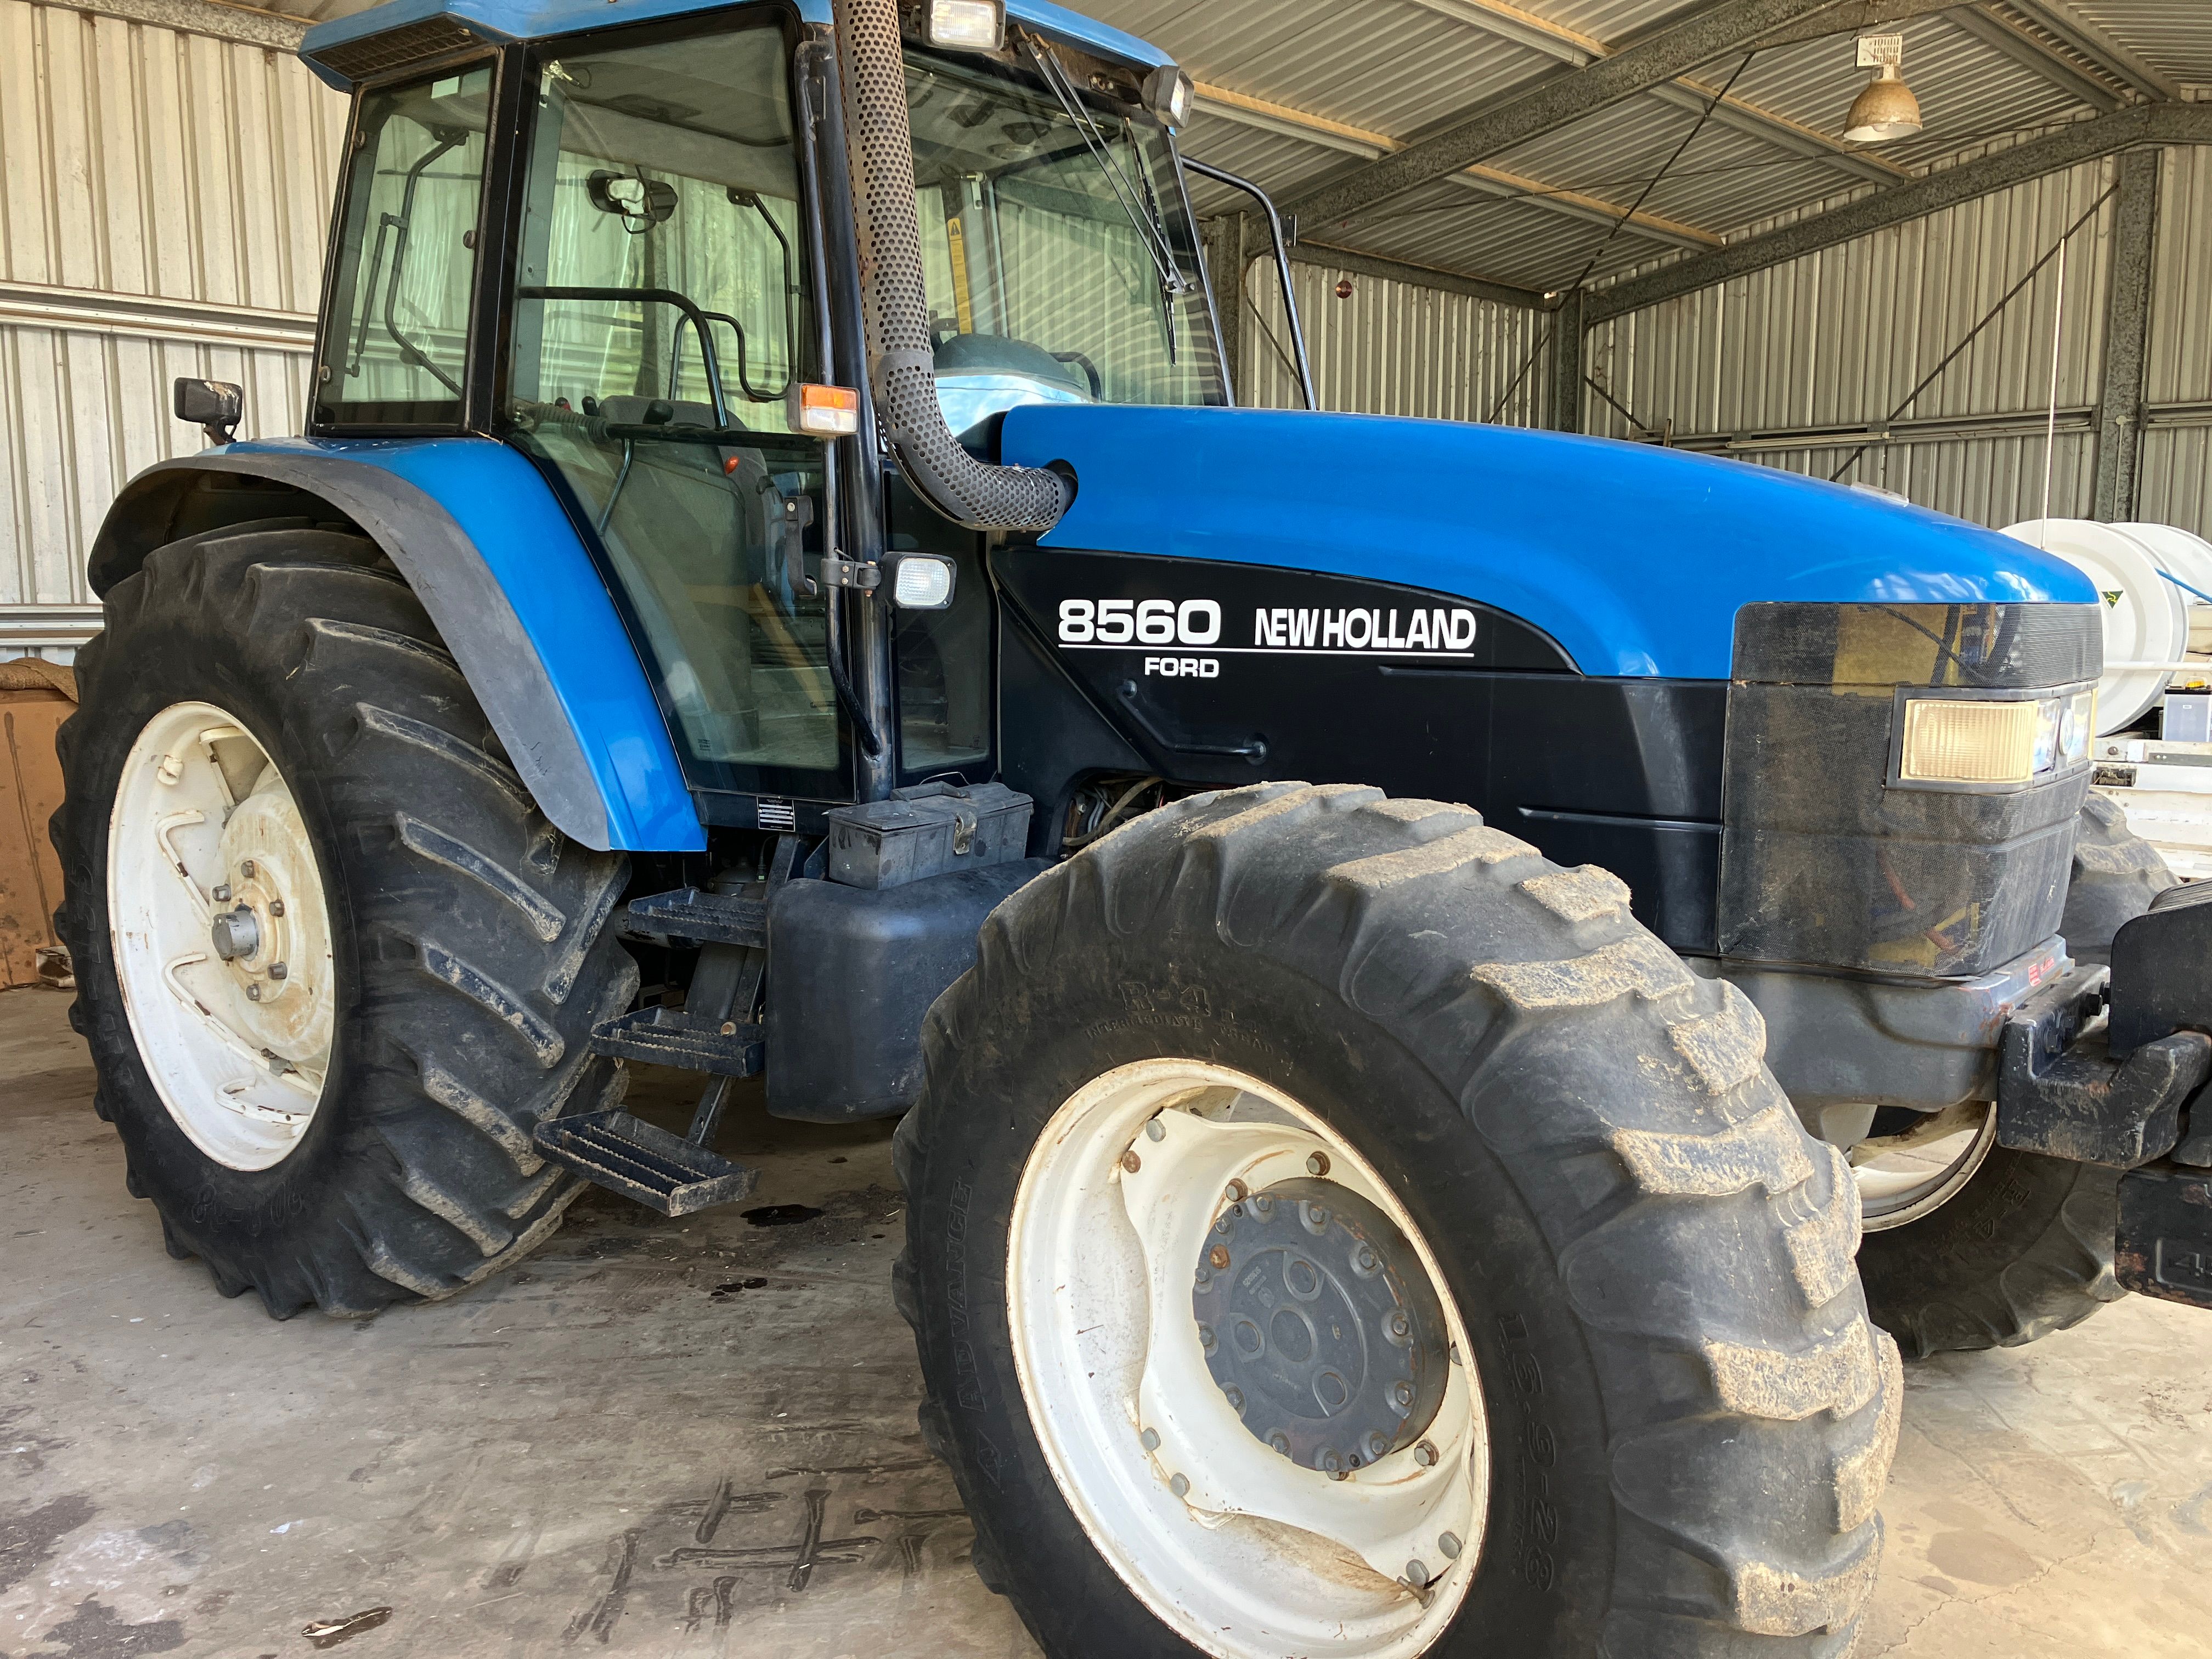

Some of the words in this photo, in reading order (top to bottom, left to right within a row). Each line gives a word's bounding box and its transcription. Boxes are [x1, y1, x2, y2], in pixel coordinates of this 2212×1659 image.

[1058, 599, 1221, 645] 8560
[1254, 608, 1319, 647] NEW
[1323, 607, 1476, 650] HOLLAND
[1144, 657, 1220, 678] FORD
[1117, 980, 1212, 1018] R-4
[945, 1180, 988, 1413] ADVANCE
